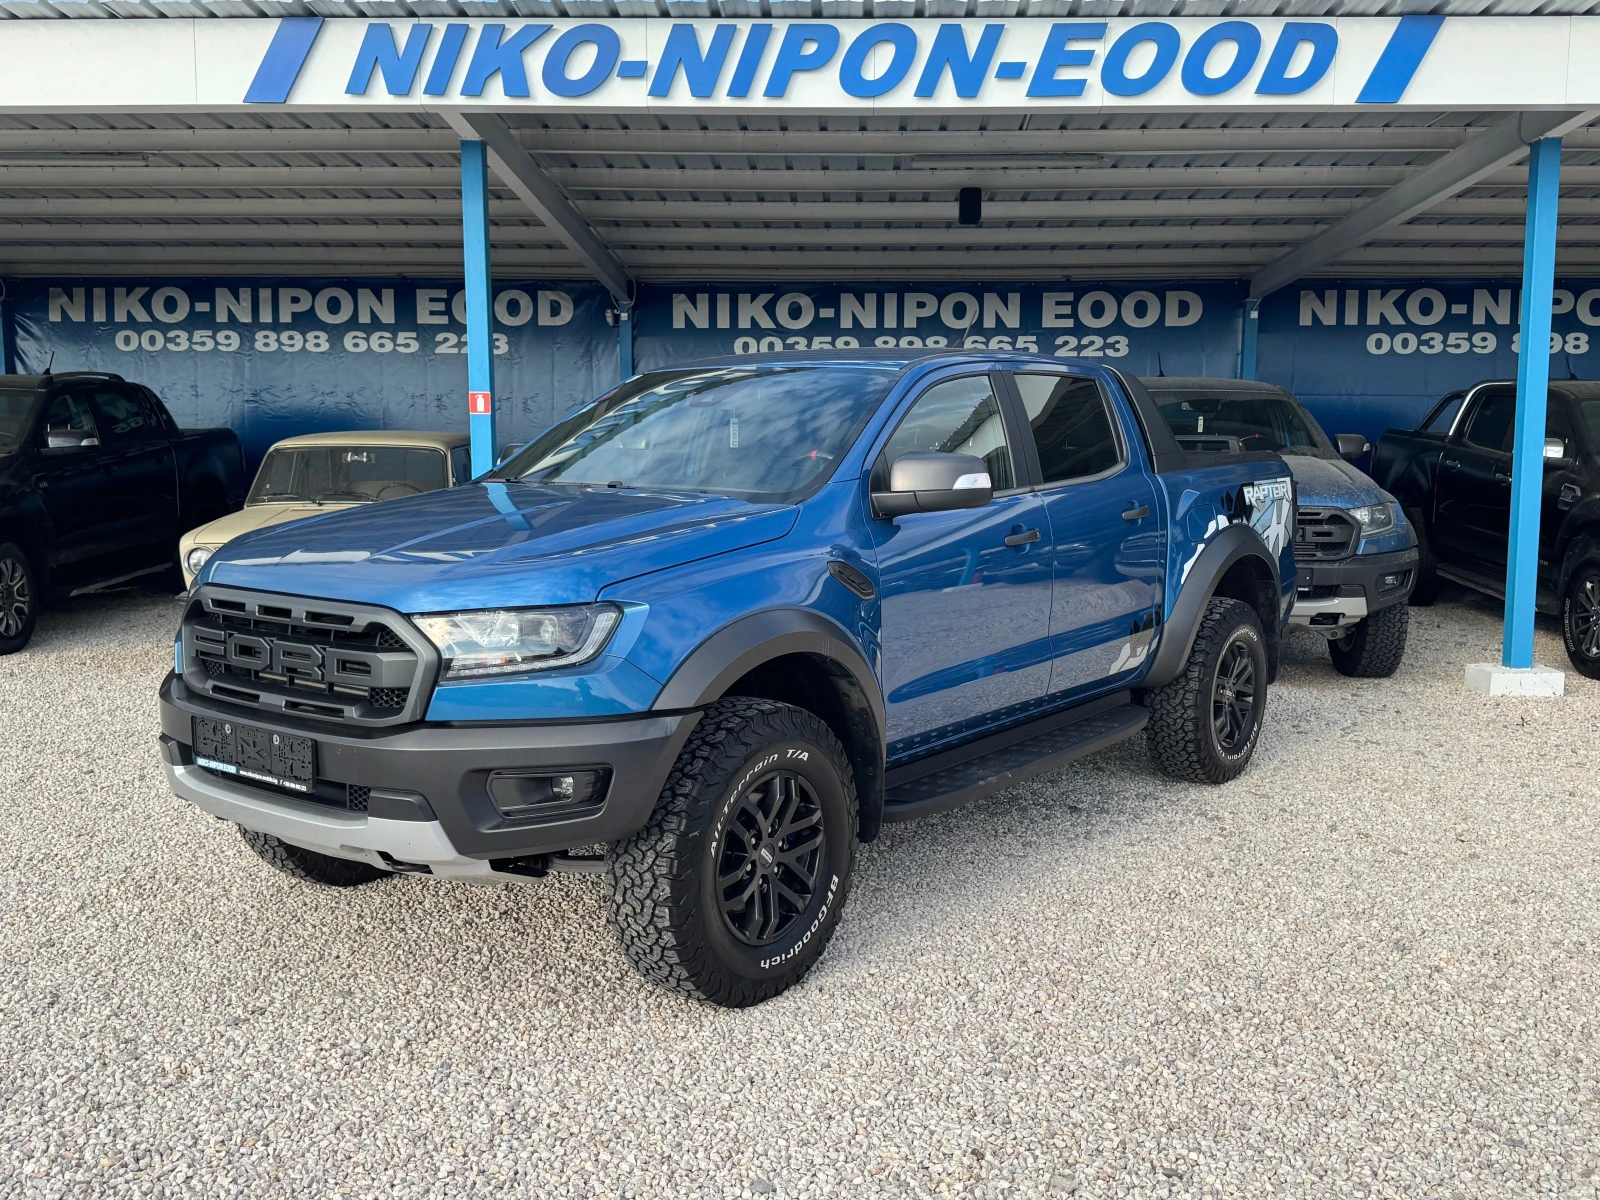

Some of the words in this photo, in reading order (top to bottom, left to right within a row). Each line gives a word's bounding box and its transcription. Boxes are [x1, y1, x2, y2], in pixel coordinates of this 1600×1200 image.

[344, 20, 1339, 99] NIKO-NIPON-EOOD
[48, 286, 396, 325] NIKO-NIPON
[672, 292, 1021, 330] NIKO-NIPON
[1041, 290, 1204, 329] EOOD
[1299, 288, 1600, 326] NIKO-NPO
[114, 329, 241, 352] 00359
[254, 330, 330, 352] 898
[343, 331, 420, 353] 665
[434, 332, 509, 355] 23
[1054, 335, 1129, 357] 223
[1365, 332, 1497, 355] 00359
[1242, 482, 1291, 508] RAPTOR
[190, 624, 418, 688] FORD
[710, 753, 779, 858] All-Terrain
[786, 748, 810, 762] T/A
[760, 874, 839, 969] BFGoodrich
